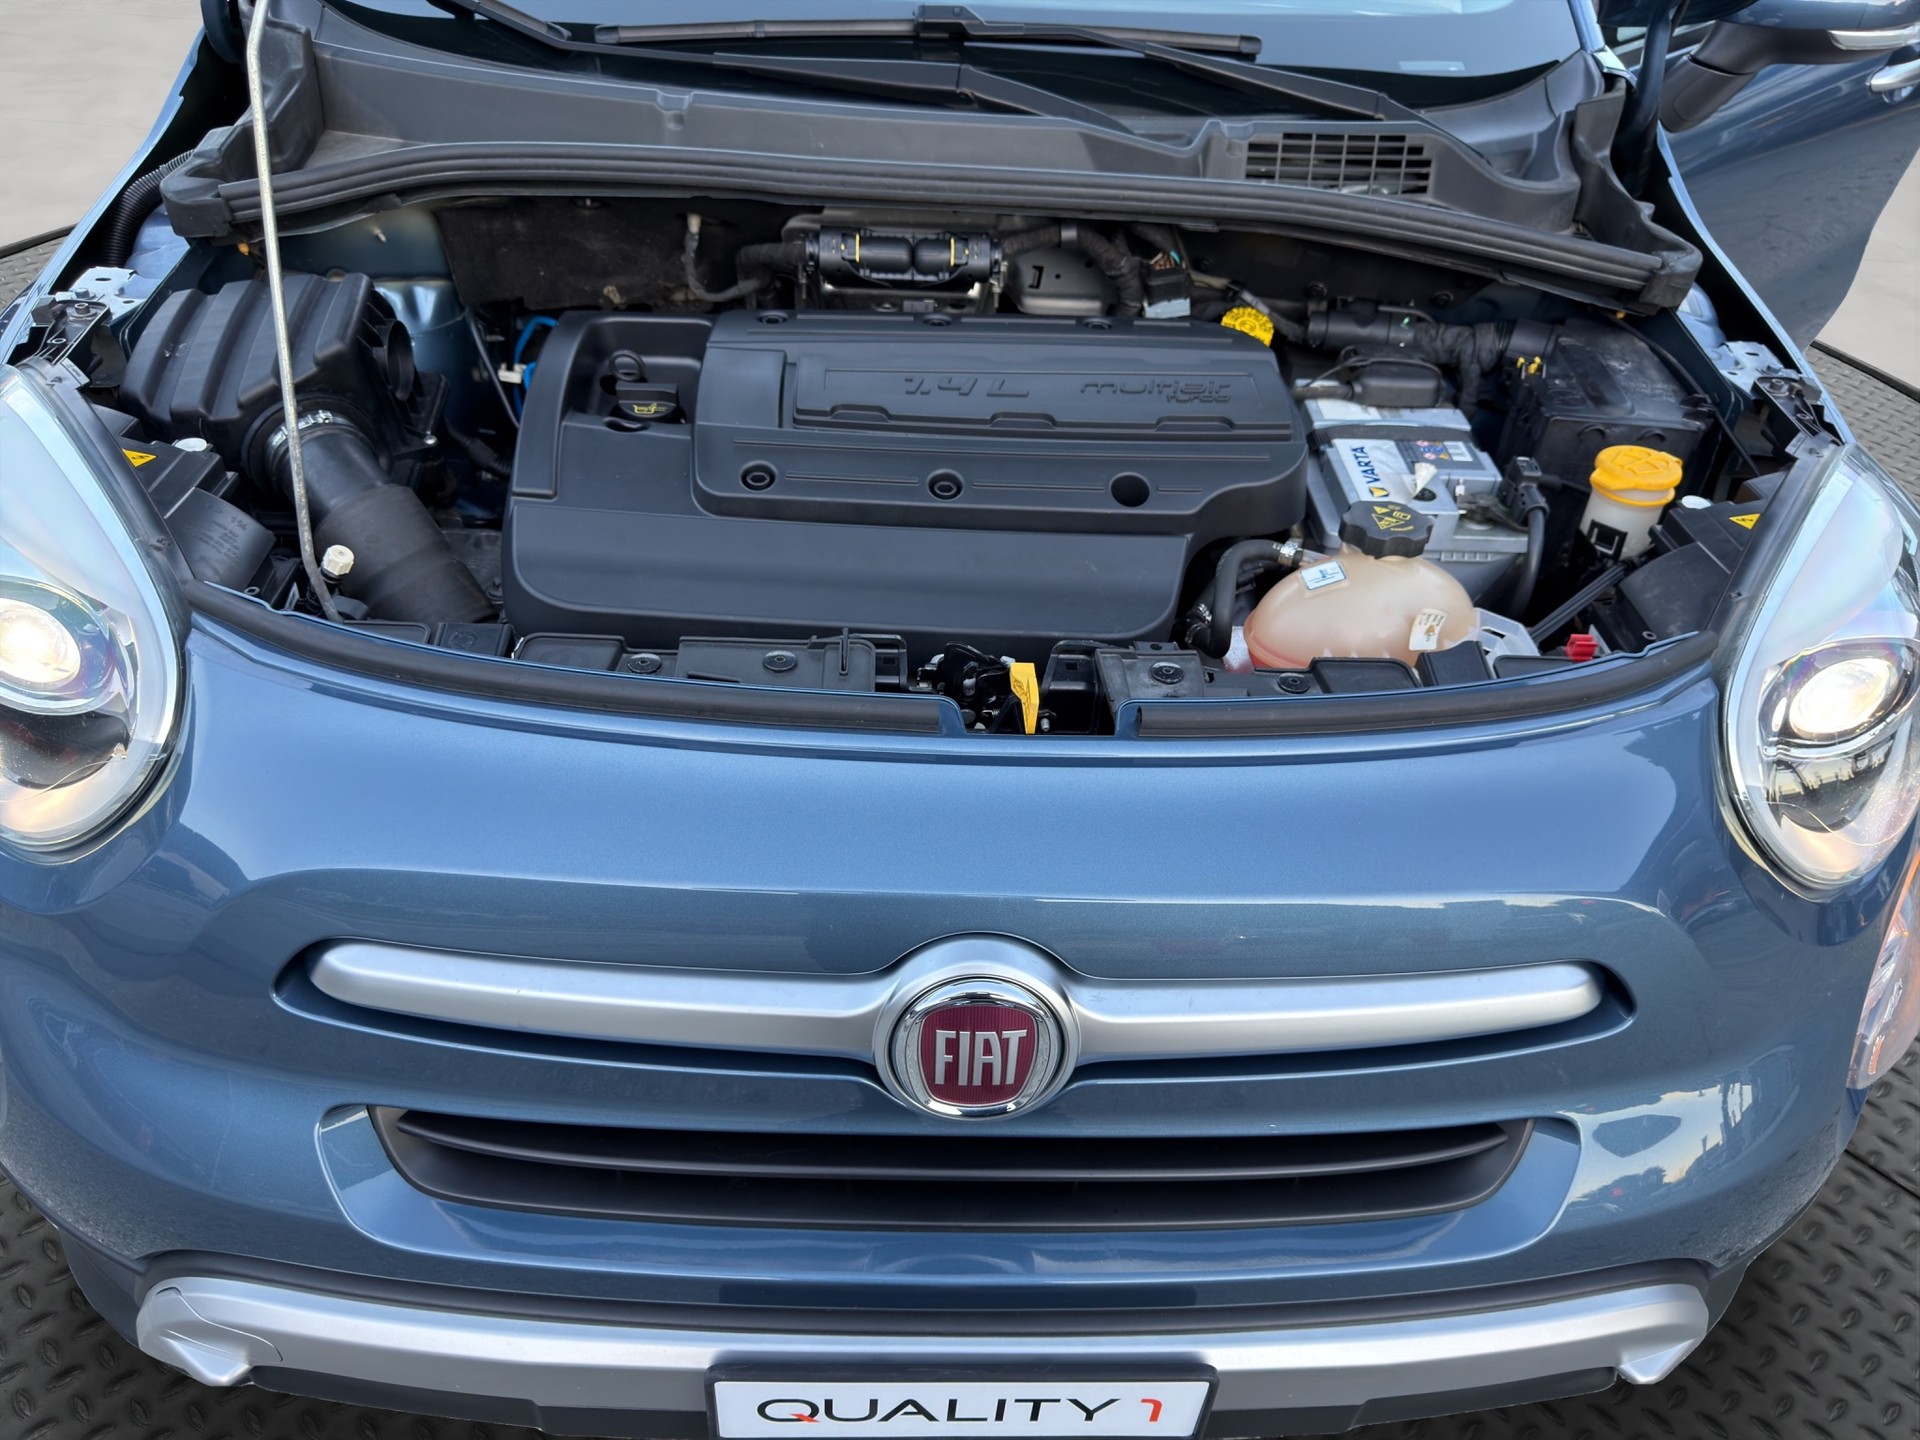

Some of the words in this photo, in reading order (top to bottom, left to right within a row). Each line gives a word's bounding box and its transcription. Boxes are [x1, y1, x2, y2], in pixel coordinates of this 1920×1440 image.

[1351, 446, 1381, 485] VARTA
[934, 1029, 1028, 1086] FIAT
[757, 1398, 1121, 1423] QUALITY
[1140, 1398, 1162, 1422] 1
